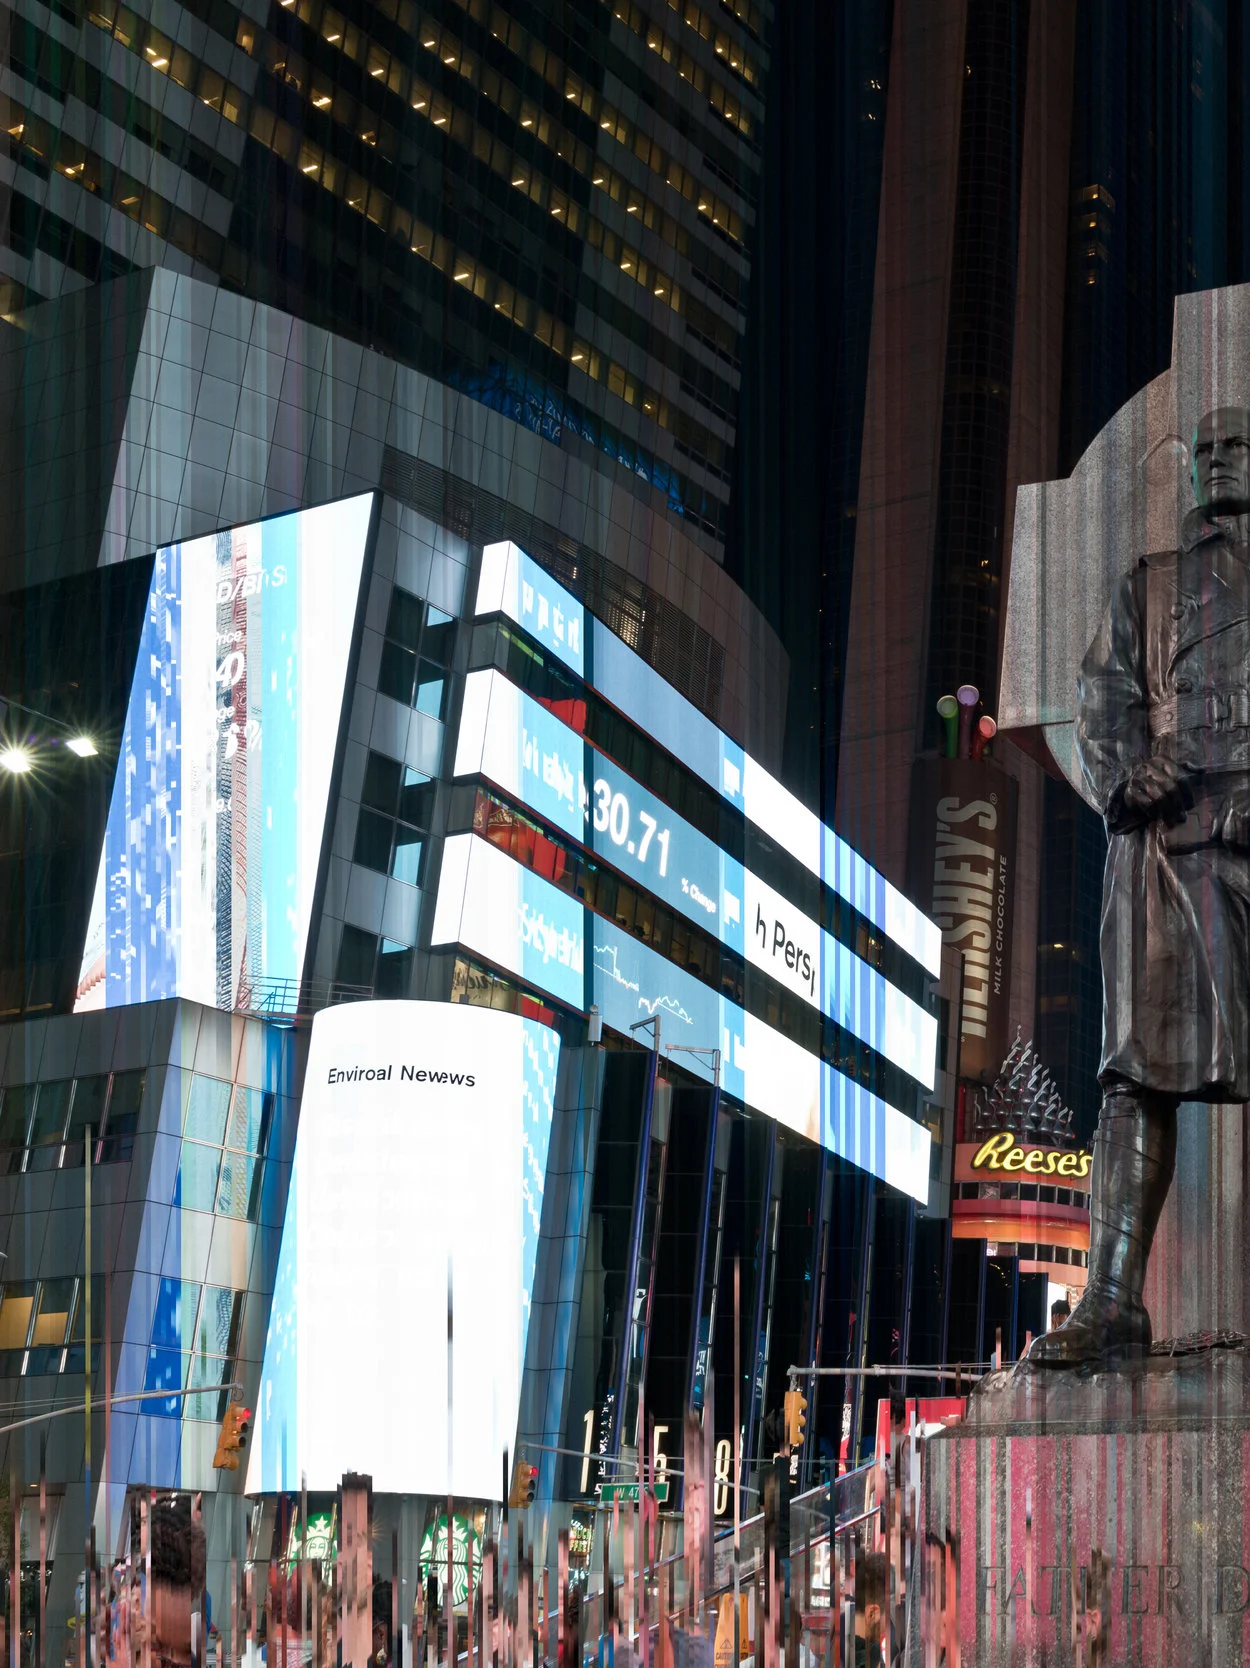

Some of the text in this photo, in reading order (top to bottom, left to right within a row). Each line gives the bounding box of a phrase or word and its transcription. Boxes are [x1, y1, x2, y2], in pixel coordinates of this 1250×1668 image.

[993, 853, 1008, 995] MILK CHOCOLATE
[327, 1065, 392, 1085] Enviroal
[973, 1132, 1093, 1177] Reese's
